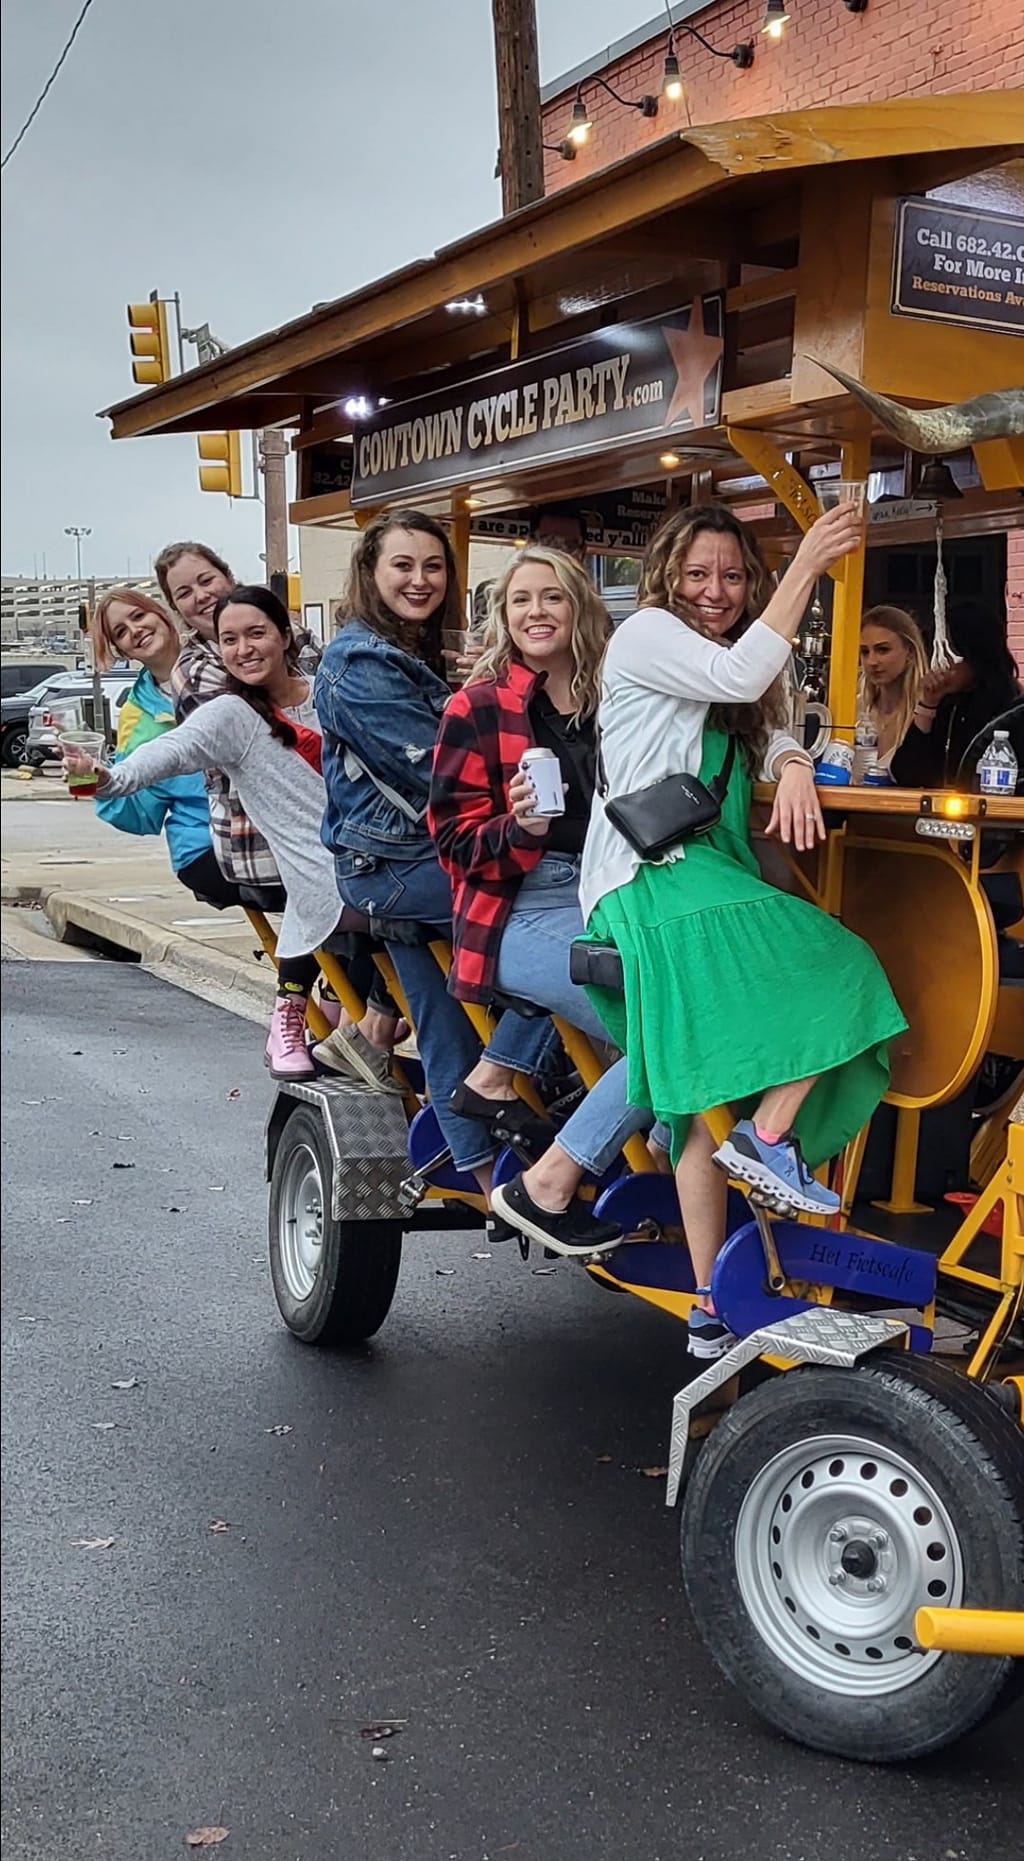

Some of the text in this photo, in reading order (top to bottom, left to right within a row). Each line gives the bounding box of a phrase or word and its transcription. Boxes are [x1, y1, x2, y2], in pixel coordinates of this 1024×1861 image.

[916, 228, 952, 250] Call
[933, 253, 962, 274] For
[966, 259, 1011, 282] More
[912, 275, 1002, 303] Reservations
[359, 409, 464, 479] COWTOWN
[467, 382, 539, 449] CYCLE
[478, 520, 504, 533] are
[808, 1243, 915, 1284] Het Fietscafe
